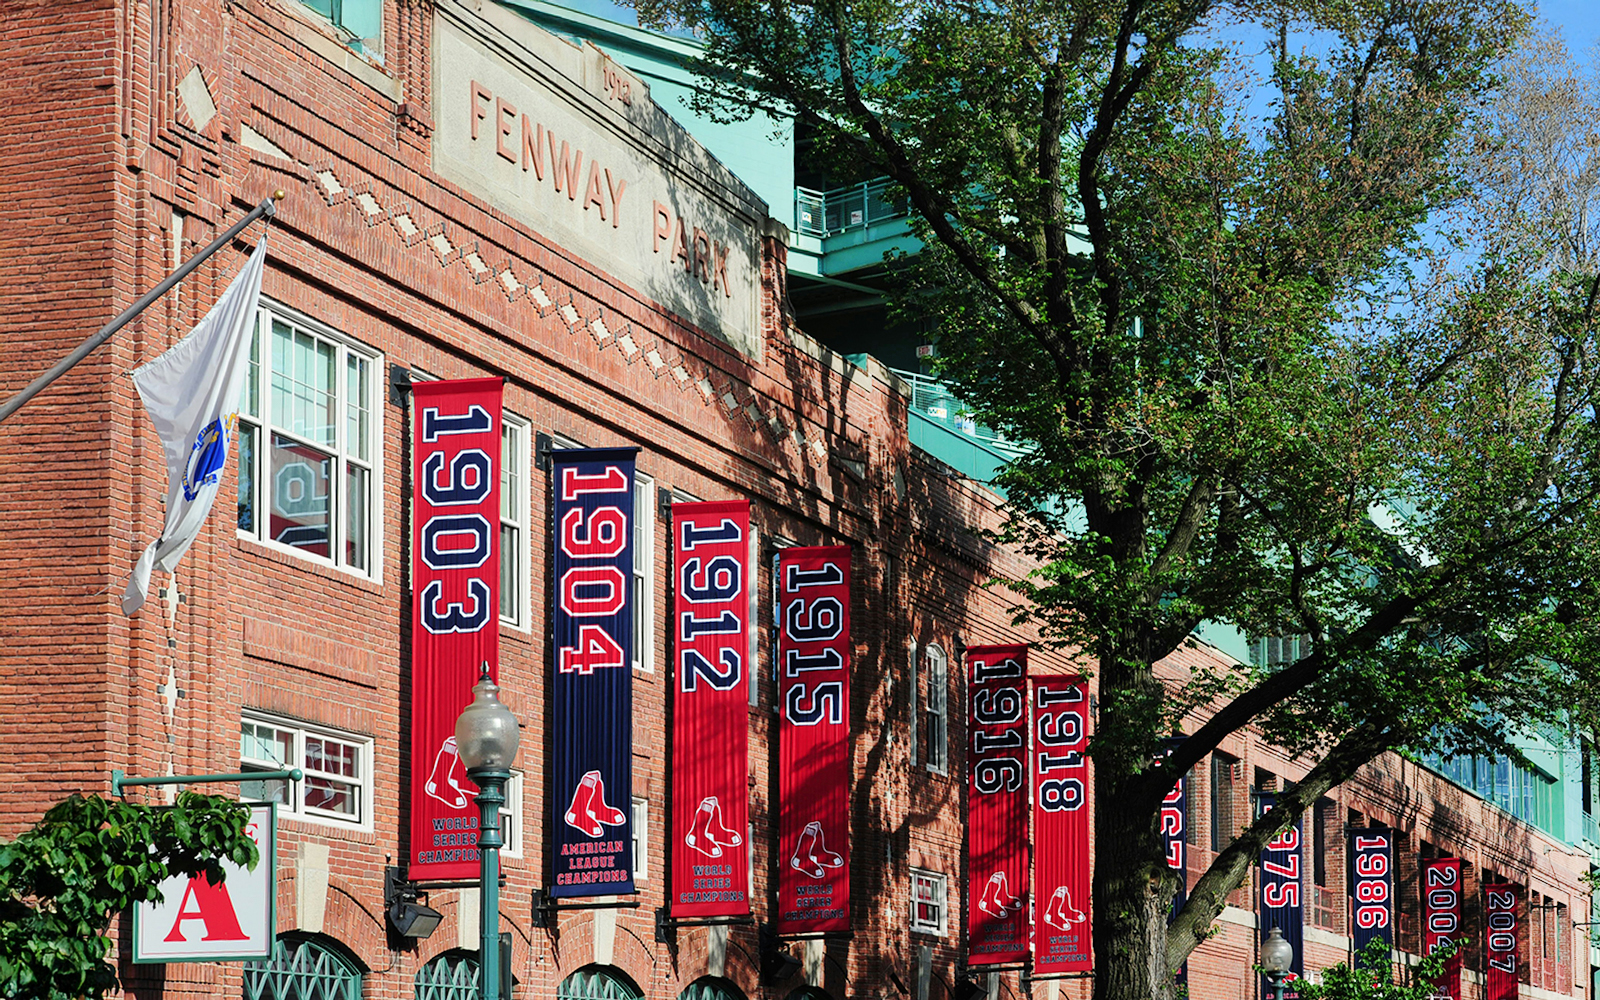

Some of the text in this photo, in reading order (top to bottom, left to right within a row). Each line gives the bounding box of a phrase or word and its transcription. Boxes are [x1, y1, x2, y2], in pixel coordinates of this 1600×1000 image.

[603, 67, 632, 106] 1912
[470, 79, 731, 298] FENWAY PARK
[420, 405, 492, 634] 1903
[559, 466, 628, 675] 1904
[681, 519, 742, 692] 1912
[786, 563, 843, 726] 1915
[974, 659, 1022, 794] 1916
[1037, 684, 1085, 813] 1918
[432, 817, 478, 831] WORLD
[433, 832, 477, 847] SERIES
[561, 840, 624, 856] AMERICAN
[418, 849, 482, 864] CHAMPION
[569, 855, 615, 870] LEAGUE
[1264, 805, 1299, 908] 975
[556, 869, 628, 886] CHAMPIONS
[692, 864, 732, 876] WORLD
[693, 877, 731, 890] SERIES
[1356, 835, 1389, 929] 1986
[680, 890, 744, 904] CHAMPIONS
[796, 884, 833, 896] WORLD
[163, 869, 250, 942] A
[796, 896, 832, 908] SERIES
[784, 908, 844, 921] CHAMPIONS
[1049, 935, 1079, 944] WORLD
[1489, 891, 1515, 974] 2007
[974, 943, 1025, 954] CHAMPIONS
[1050, 945, 1078, 954] SERIES
[1040, 953, 1088, 964] CHAMPIONS
